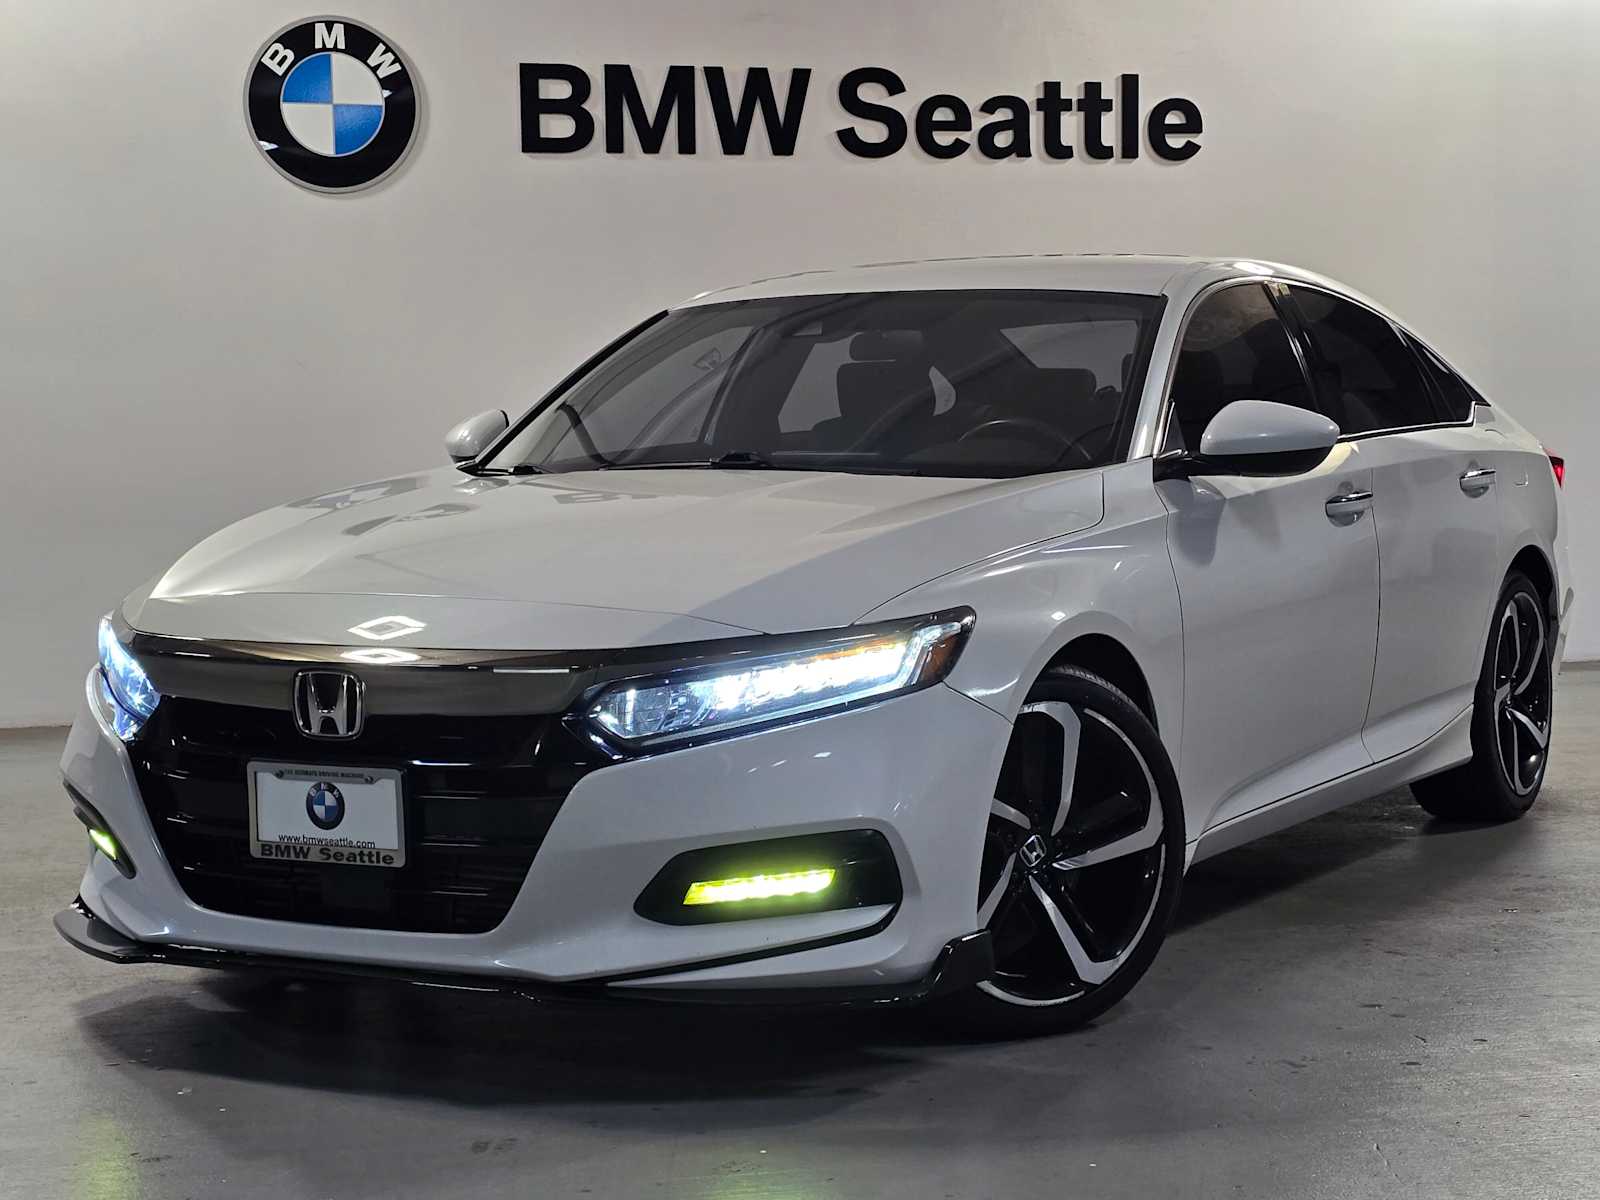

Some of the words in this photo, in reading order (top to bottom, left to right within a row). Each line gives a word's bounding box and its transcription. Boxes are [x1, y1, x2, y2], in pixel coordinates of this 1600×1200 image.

[260, 22, 402, 79] BMW
[519, 62, 812, 156] BMW
[836, 66, 1203, 161] Seattle
[260, 843, 311, 859] BMW
[319, 847, 394, 865] Seattle
[278, 834, 376, 850] www.bmwseattle.com
